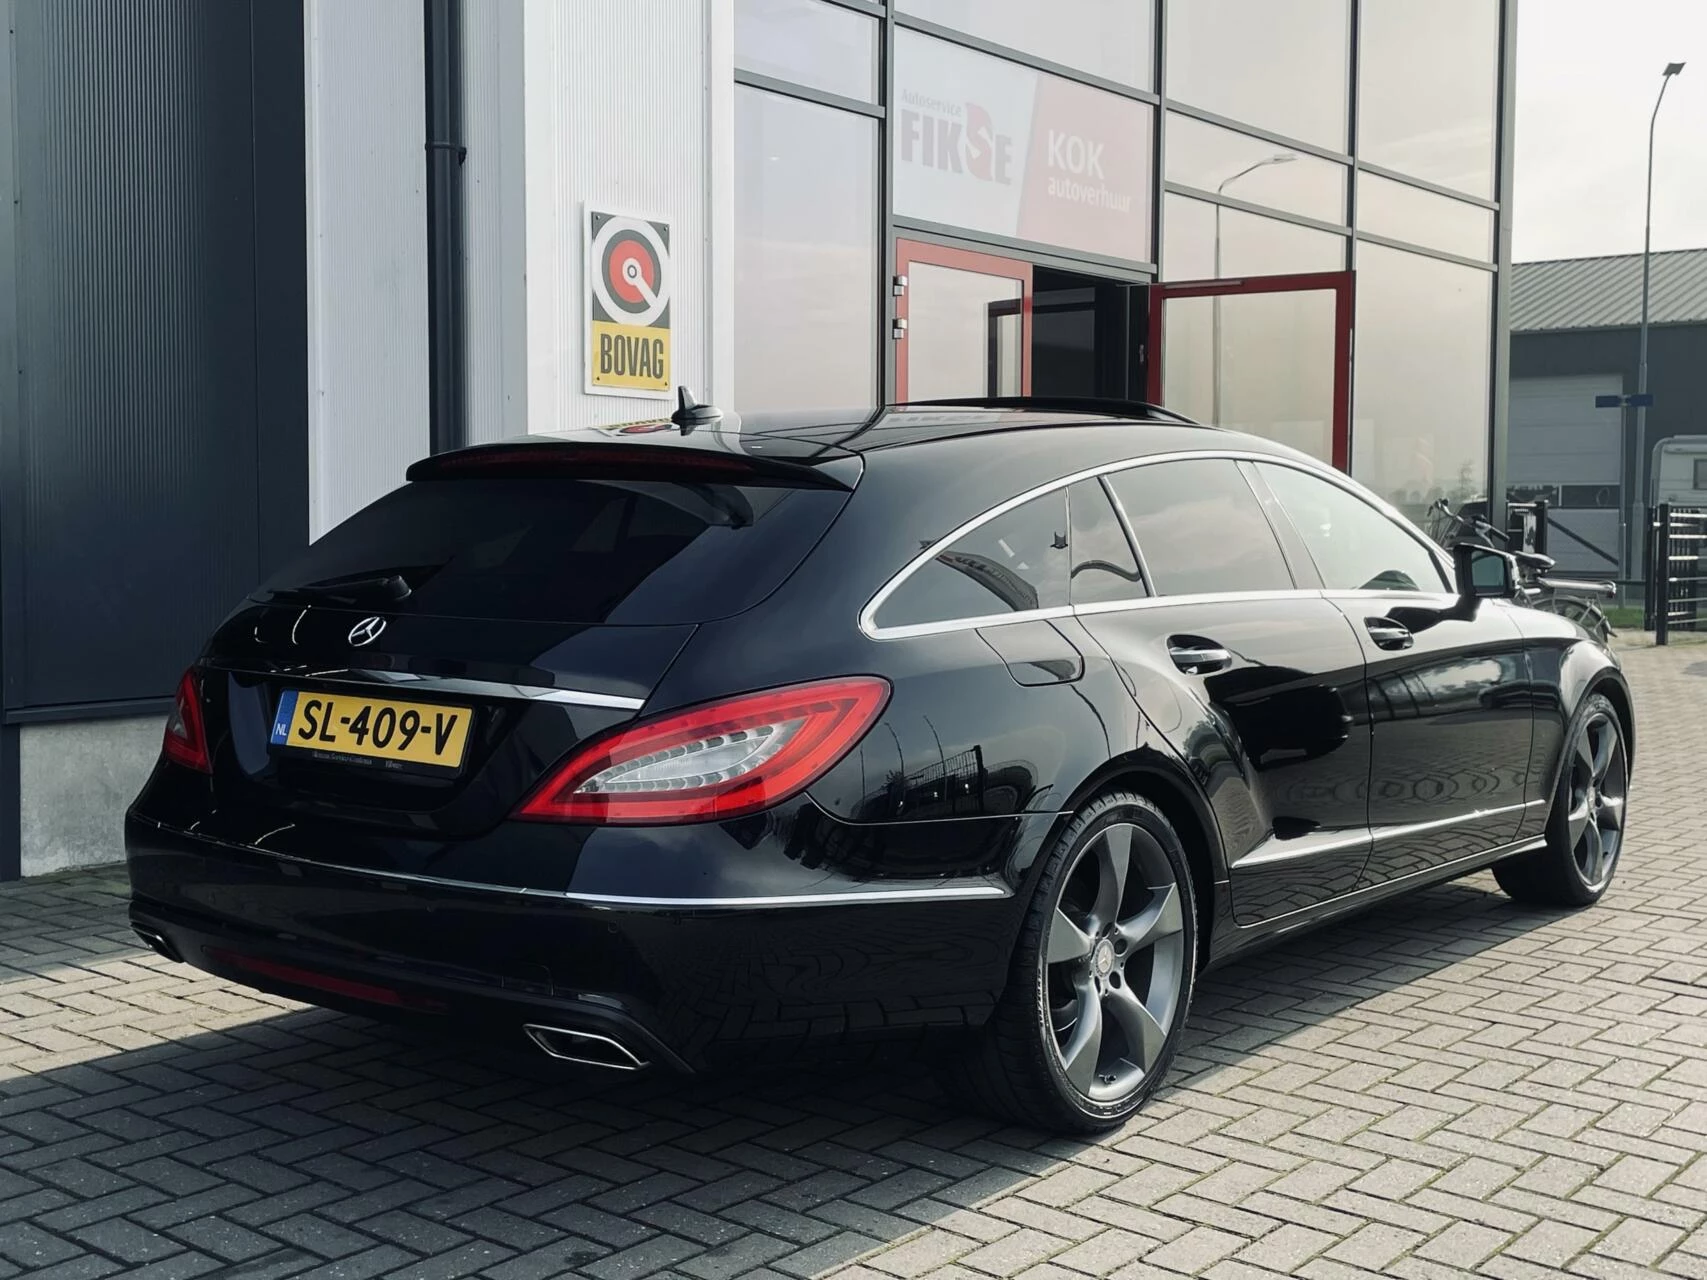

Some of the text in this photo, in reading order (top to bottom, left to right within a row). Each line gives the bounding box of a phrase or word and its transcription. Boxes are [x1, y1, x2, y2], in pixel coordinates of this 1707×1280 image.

[901, 89, 962, 116] Autoservice
[901, 101, 1013, 186] FIKSE
[1047, 129, 1105, 180] KOK
[1048, 176, 1132, 213] autoverhuur
[600, 333, 664, 379] BOVAG
[275, 723, 288, 736] NL
[298, 699, 458, 756] SL-409-V
